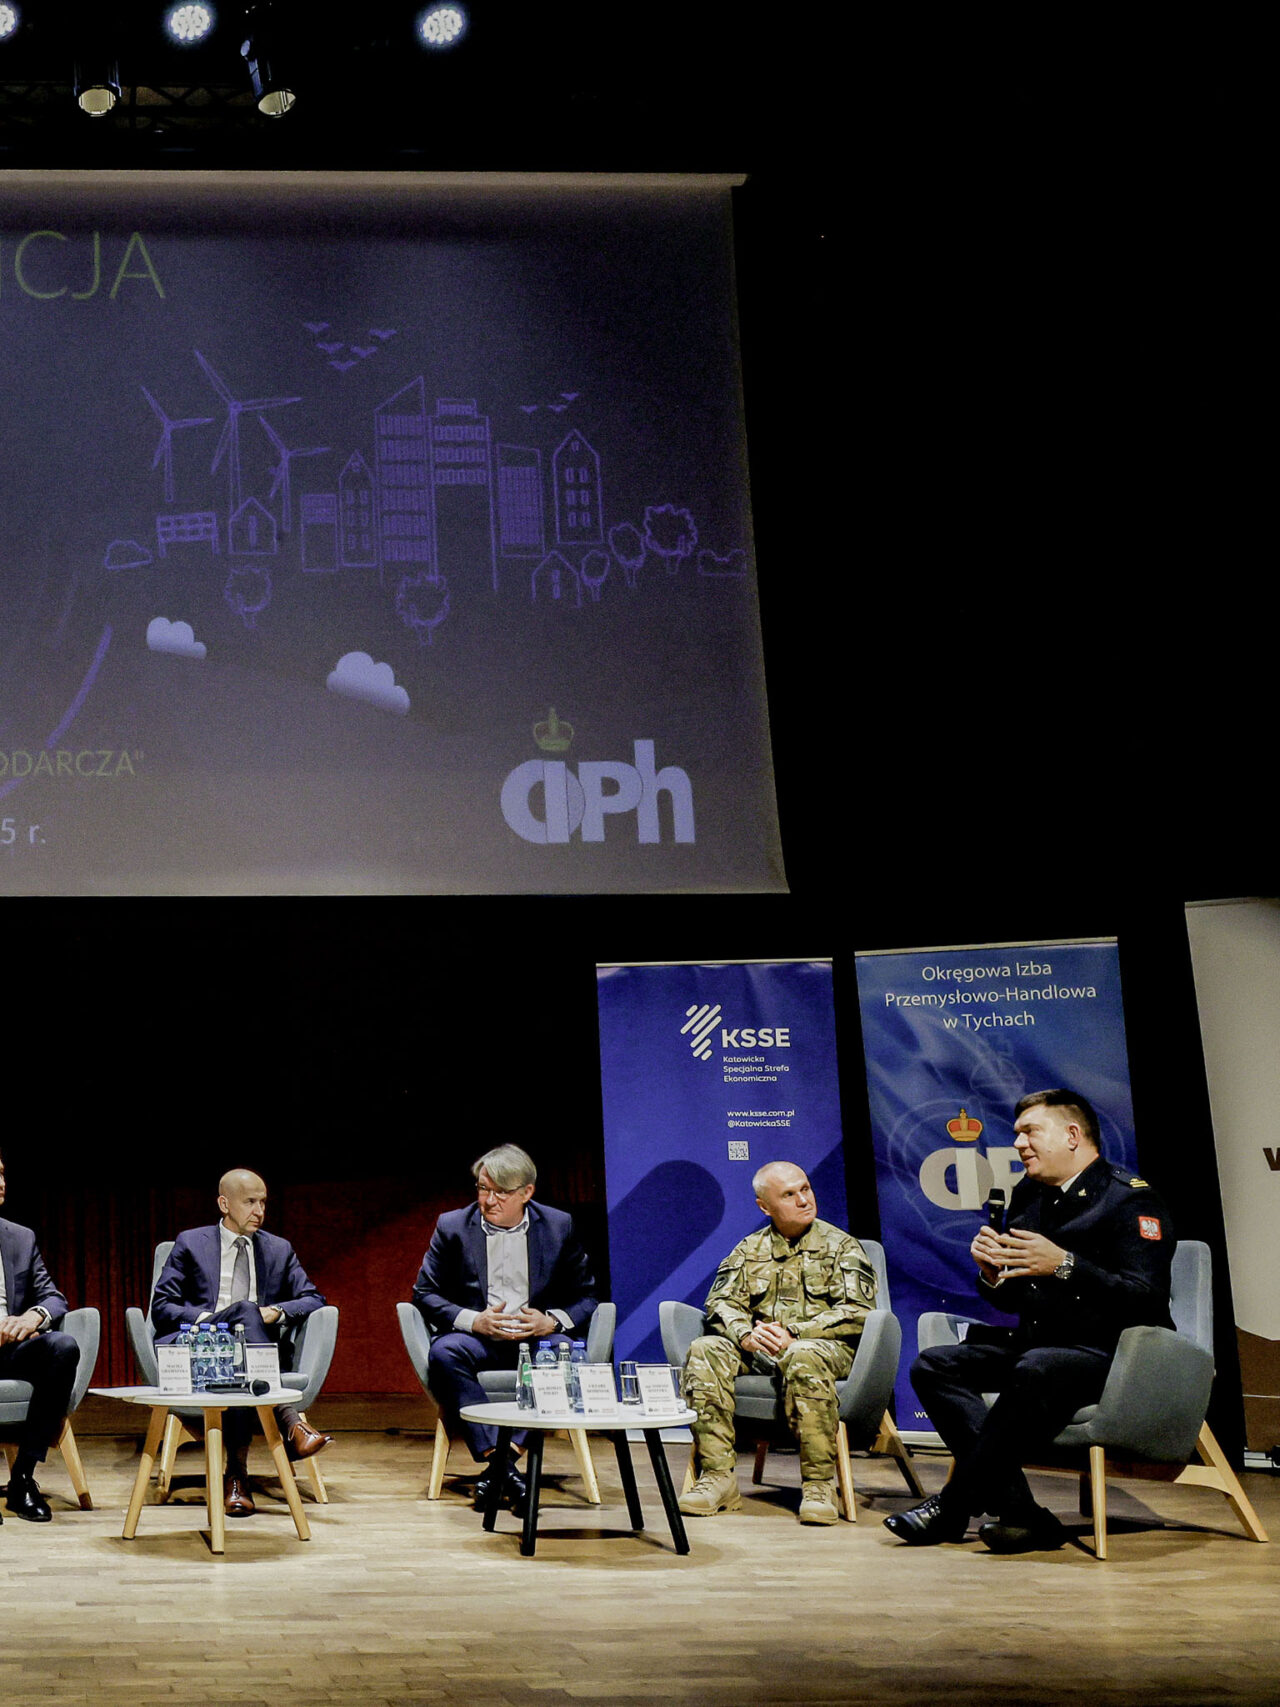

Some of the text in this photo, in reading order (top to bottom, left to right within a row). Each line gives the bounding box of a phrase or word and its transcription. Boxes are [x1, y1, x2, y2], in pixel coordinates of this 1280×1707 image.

[29, 825, 46, 844] r.
[922, 961, 1052, 983] Okręgowa Izba
[885, 984, 1097, 1009] Przemysłowo-Handlowa
[943, 1011, 1035, 1031] w Tychach
[722, 1028, 791, 1048] KSSE
[723, 1064, 790, 1074] Specjalna Strefa
[723, 1075, 777, 1083] Ekonomiczna
[727, 1109, 795, 1118] www.ksse.com.pl
[727, 1119, 791, 1128] @KatowickaSSE
